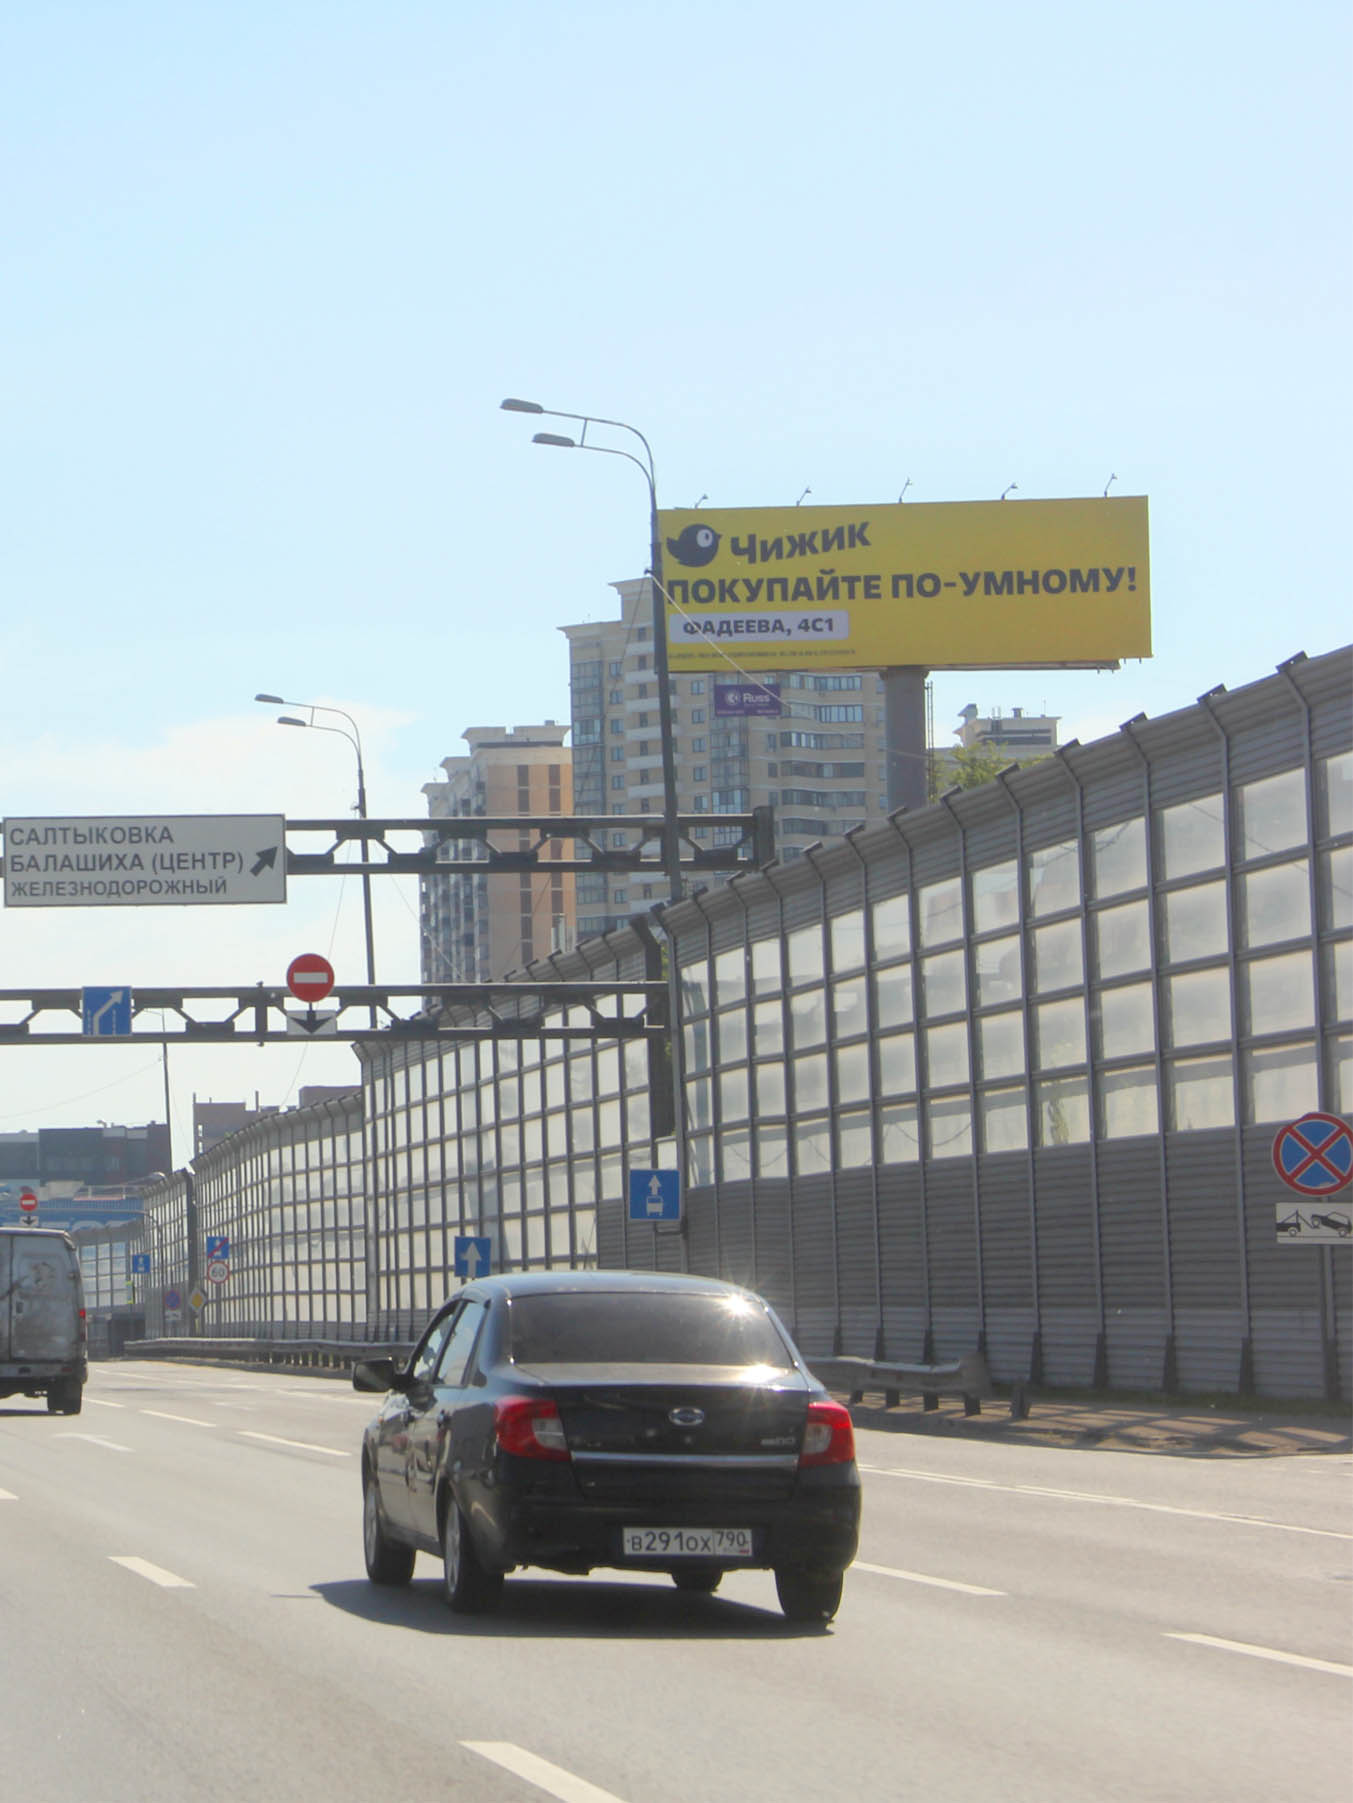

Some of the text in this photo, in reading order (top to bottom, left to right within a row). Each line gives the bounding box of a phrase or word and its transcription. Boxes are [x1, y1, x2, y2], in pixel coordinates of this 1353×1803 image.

[667, 567, 1137, 605] ПОКУПАЙТЕ ПО-УМНОМУ!
[683, 618, 793, 637] ФАДЕЕВА,
[9, 826, 174, 846] САЛТЫКОВКА
[10, 852, 244, 874] БАЛАШИХА (ЦЕНТР)
[11, 876, 228, 898] ЖЕЛЕЗНОДОРОЖНЫЙ
[716, 1531, 747, 1546] 790
